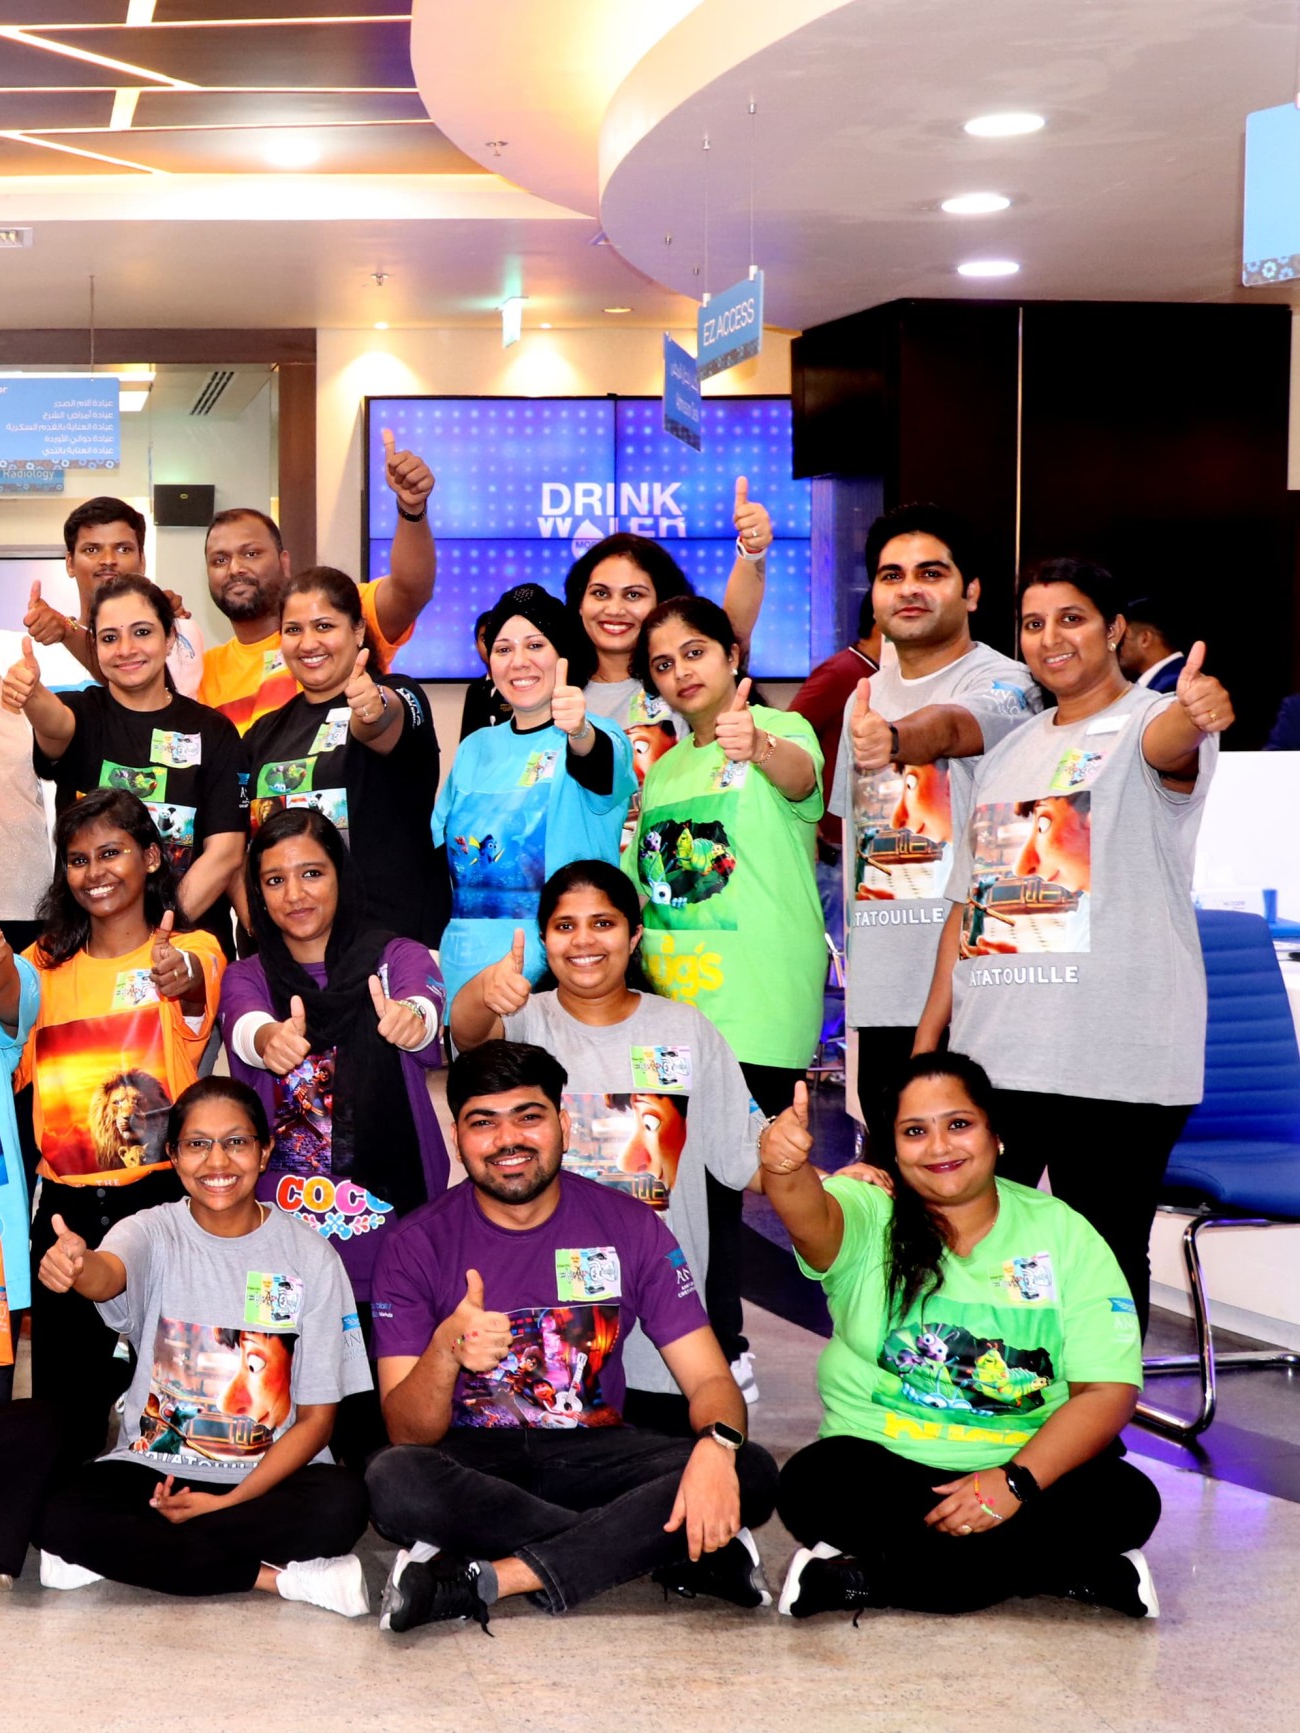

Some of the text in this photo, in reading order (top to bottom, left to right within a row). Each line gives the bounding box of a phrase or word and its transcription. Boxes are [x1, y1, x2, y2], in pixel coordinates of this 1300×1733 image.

[703, 298, 755, 346] EZ ACCESS
[3, 469, 55, 480] Radiology
[542, 482, 683, 516] DRINK
[852, 907, 945, 928] TATOUILLE
[647, 942, 725, 998] ug's
[970, 966, 1079, 988] ATATOUILLE
